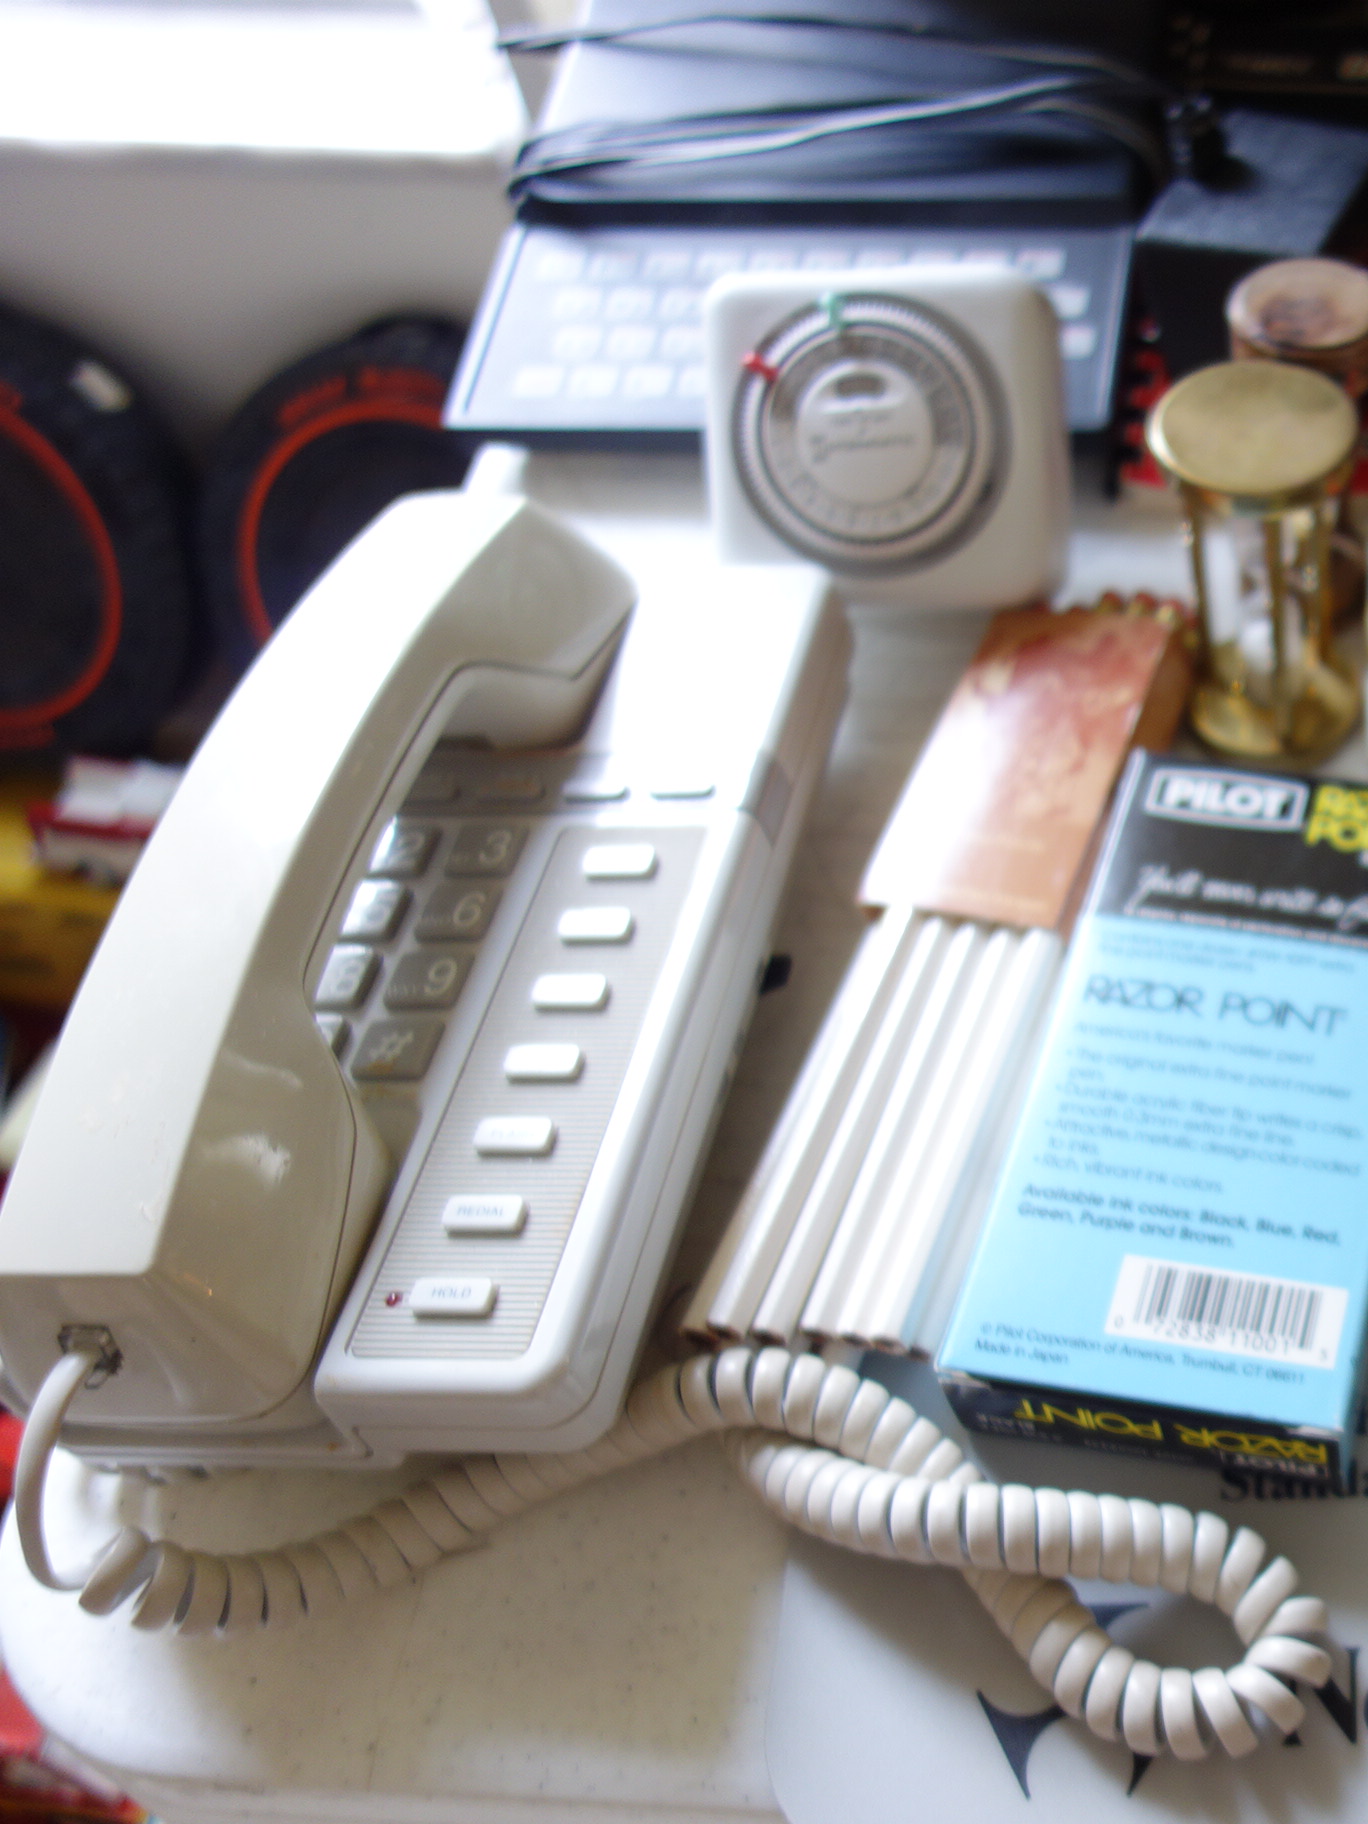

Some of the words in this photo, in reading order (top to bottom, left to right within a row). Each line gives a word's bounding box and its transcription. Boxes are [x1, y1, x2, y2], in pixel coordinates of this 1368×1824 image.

[1161, 775, 1291, 821] PILOT
[478, 830, 513, 866] 3
[450, 890, 488, 928] 6
[424, 957, 459, 997] 9
[1086, 974, 1206, 1018] RAZOR
[1218, 990, 1349, 1038] POINT
[456, 1205, 506, 1218] REDIAL
[1023, 1183, 1107, 1210] Available
[1109, 1194, 1134, 1212] ink
[1017, 1201, 1076, 1226] Green,
[1079, 1210, 1136, 1235] Purple
[1139, 1220, 1177, 1240] and
[430, 1286, 473, 1299] HOLD
[973, 1338, 1013, 1359] Made
[1014, 1344, 1027, 1360] in
[1026, 1347, 1071, 1369] Japan
[996, 1322, 1025, 1343] Pilot
[1025, 1327, 1102, 1356] Corporation
[1102, 1340, 1120, 1357] of
[1119, 1343, 1176, 1366] America,
[1014, 1397, 1166, 1442] POINT
[1174, 1424, 1329, 1466] RAZOR
